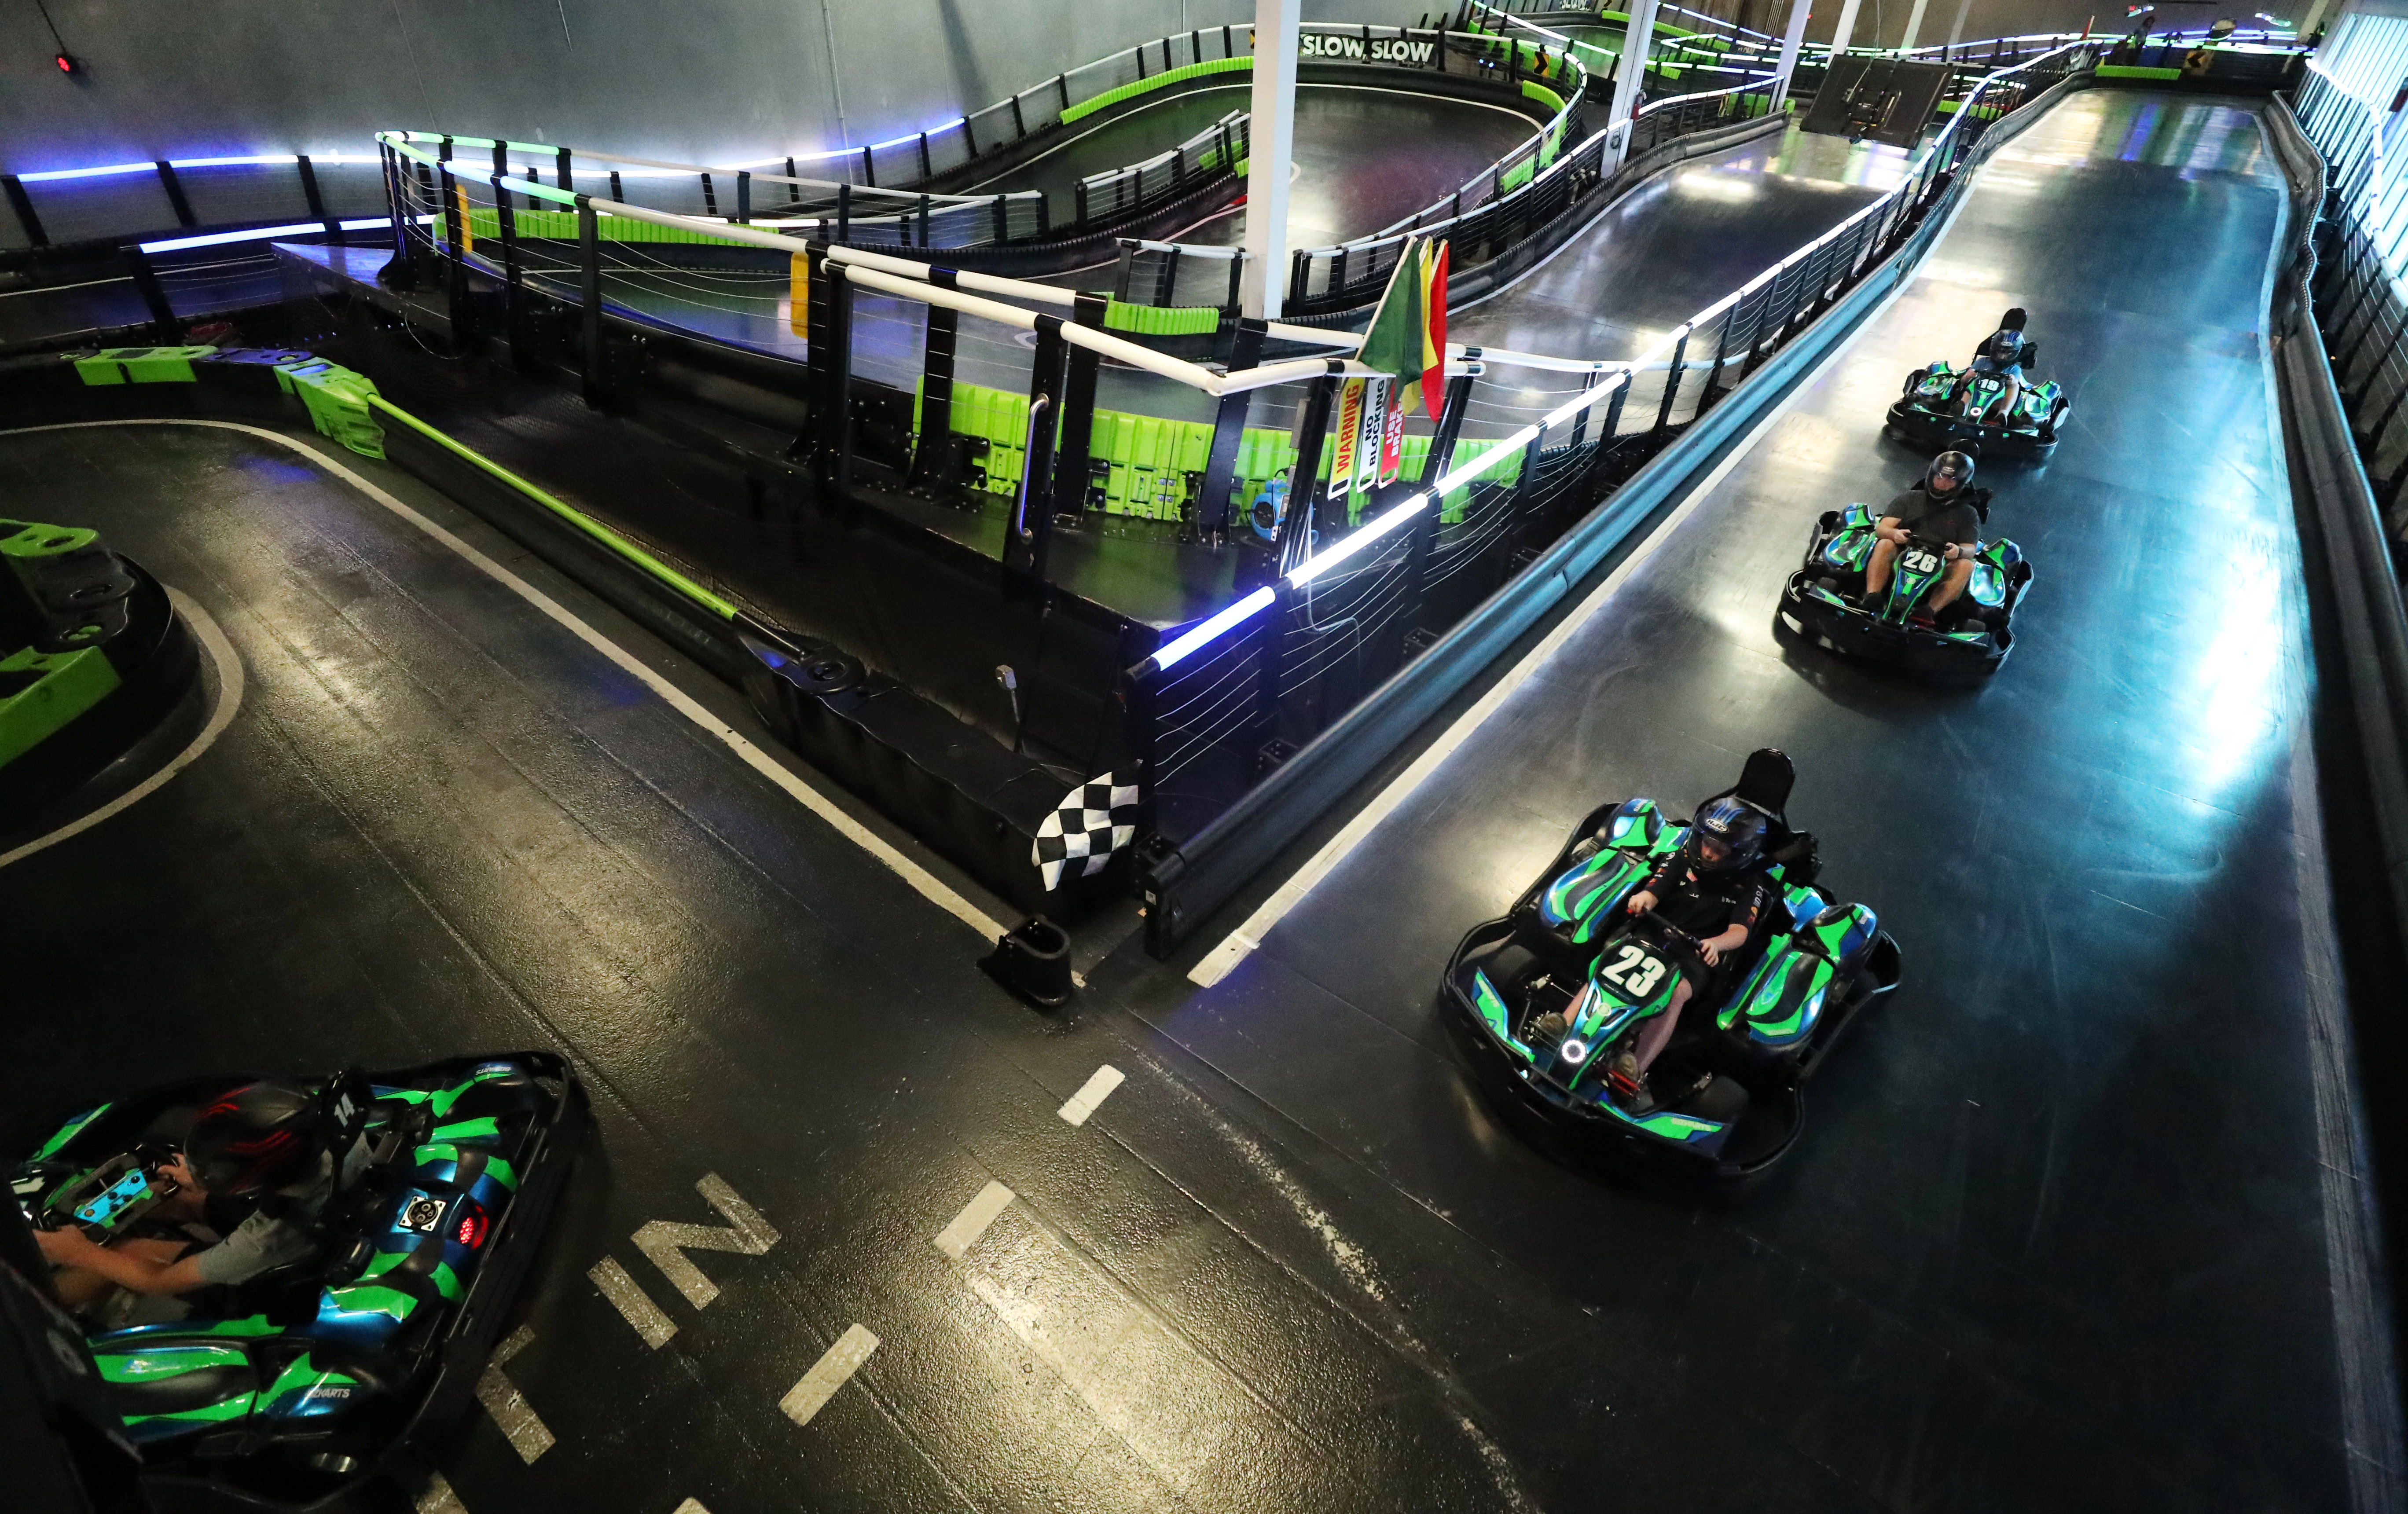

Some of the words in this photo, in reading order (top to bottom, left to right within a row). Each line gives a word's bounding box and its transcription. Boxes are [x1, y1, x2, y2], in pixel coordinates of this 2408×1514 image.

[1371, 40, 1434, 62] SLOW
[1980, 379, 1999, 391] 19
[1336, 385, 1359, 474] WARNING
[1365, 415, 1374, 442] NO
[1369, 379, 1384, 466] BLOCKING
[1386, 410, 1397, 445] USE
[1902, 551, 1938, 573] 26
[1601, 945, 1667, 997] 23
[586, 1170, 782, 1350] IN
